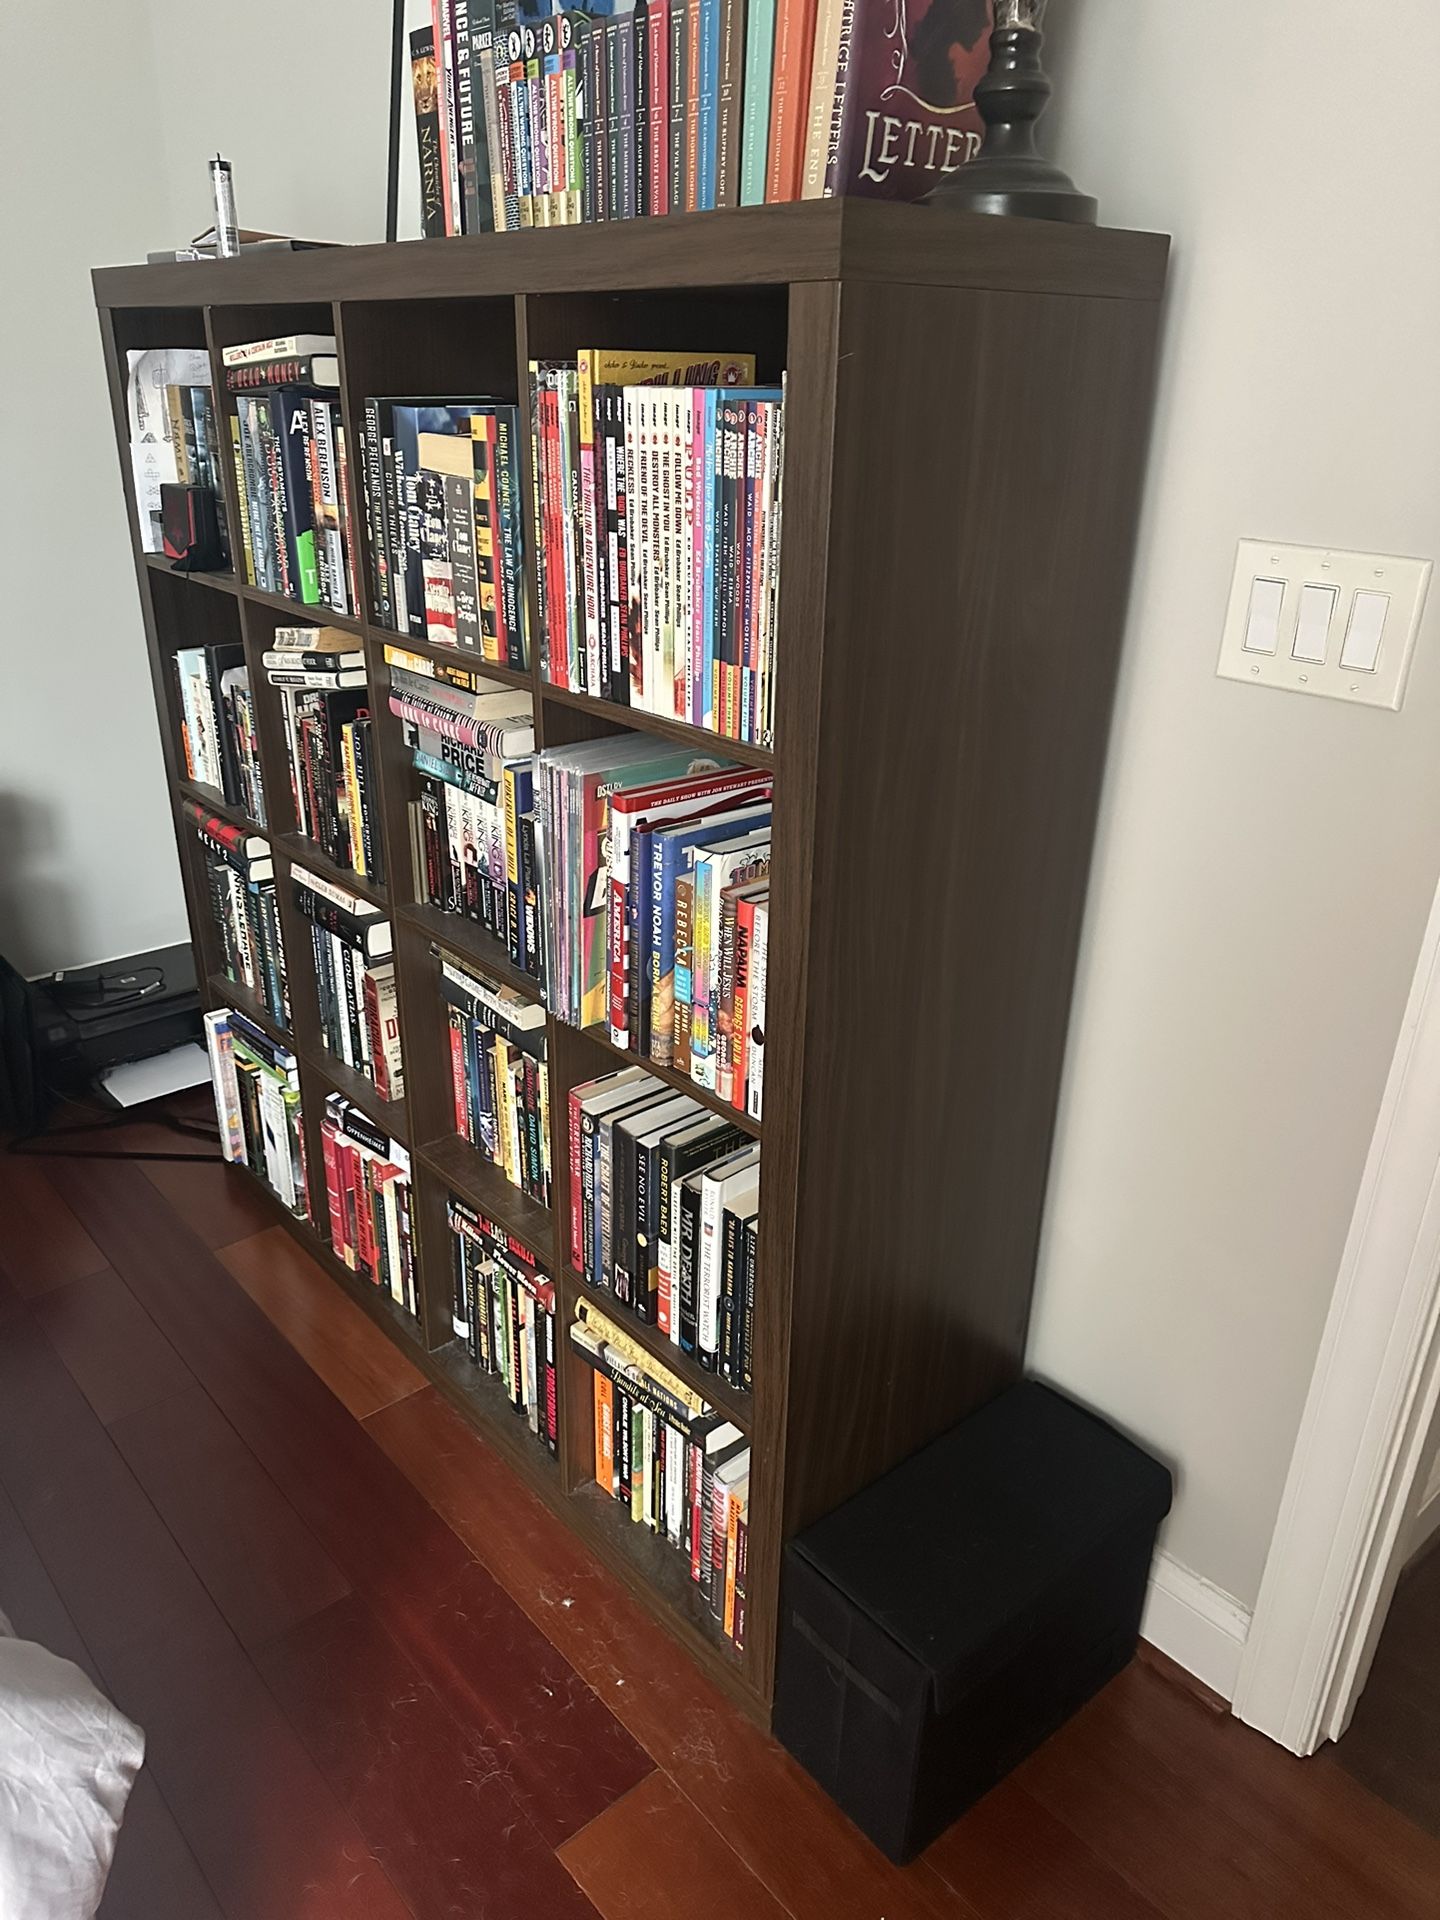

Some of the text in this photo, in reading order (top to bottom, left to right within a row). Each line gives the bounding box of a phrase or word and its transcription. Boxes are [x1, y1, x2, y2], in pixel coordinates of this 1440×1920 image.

[442, 0, 450, 38] MARVEL
[455, 0, 474, 146] NCE & FUTURE
[550, 80, 558, 96] ALL
[826, 0, 856, 166] ATRICE LETTERS
[518, 100, 526, 116] THE
[568, 108, 576, 140] WRONG
[420, 125, 436, 220] NARNIA
[552, 144, 560, 186] QUESTIONS
[720, 128, 728, 168] SLIPPERY
[808, 102, 825, 185] THE END
[858, 110, 982, 184] LETTER
[236, 366, 260, 388] DEAD
[266, 362, 300, 384] MONEY
[300, 410, 312, 482] ALEX BERENSON
[314, 408, 332, 498] ALEX BERENSON
[394, 450, 406, 506] Without
[736, 432, 744, 479] ARCHIE
[754, 434, 763, 480] ARCHIE
[276, 455, 288, 512] TESTAMENTS
[384, 472, 398, 554] CITY OF THIEVES
[406, 472, 422, 554] Tom Clancy
[498, 422, 518, 632] MICHAEL CONNELLY THE LAW OF INNOCENCE
[583, 466, 596, 620] THE THRILLING ADVENTURE HOUR
[616, 446, 629, 658] WHERE THE BODY WAS ED BRUBAKER SEAN PHILLIPS
[254, 761, 263, 794] TABLOID
[441, 734, 485, 758] RICHARD
[442, 742, 486, 780] PRICE
[198, 828, 229, 862] HEAT 2
[462, 809, 471, 842] KING
[477, 818, 486, 852] KING
[491, 824, 500, 860] KING
[522, 824, 532, 892] Lynda La Plante
[652, 842, 663, 901] TREVOR
[526, 905, 536, 954] WIDOWS
[612, 890, 623, 963] AMERICA
[652, 904, 662, 946] NOAH
[676, 900, 688, 966] REBECCA
[722, 916, 735, 999] WHEN WILL JESUS
[342, 950, 357, 1024] CLOUD ATLAS
[652, 950, 661, 985] BORN
[731, 924, 749, 1066] NAPALM GEORGE CARLIN
[751, 914, 761, 1021] BEFORE THE STORM
[652, 996, 661, 1032] CRIME
[346, 1124, 386, 1152] OPPENHEIMER
[600, 1142, 610, 1271] THE CRAFT OF INTELLIGENCE
[638, 1153, 646, 1223] SEE NO EVIL
[660, 1158, 669, 1236] ROBERT BAER
[460, 1218, 537, 1295] Killers Flower Moon
[681, 1234, 693, 1306] DEATH
[702, 1242, 712, 1343] THE TERRORIST WATCH
[546, 1364, 557, 1441] ZEROZEROZERO
[611, 1367, 666, 1417] Bandits at Sea
[640, 1379, 652, 1392] ALL
[652, 1386, 678, 1410] NATIONS
[711, 1487, 725, 1569] BLOOD YEAR
